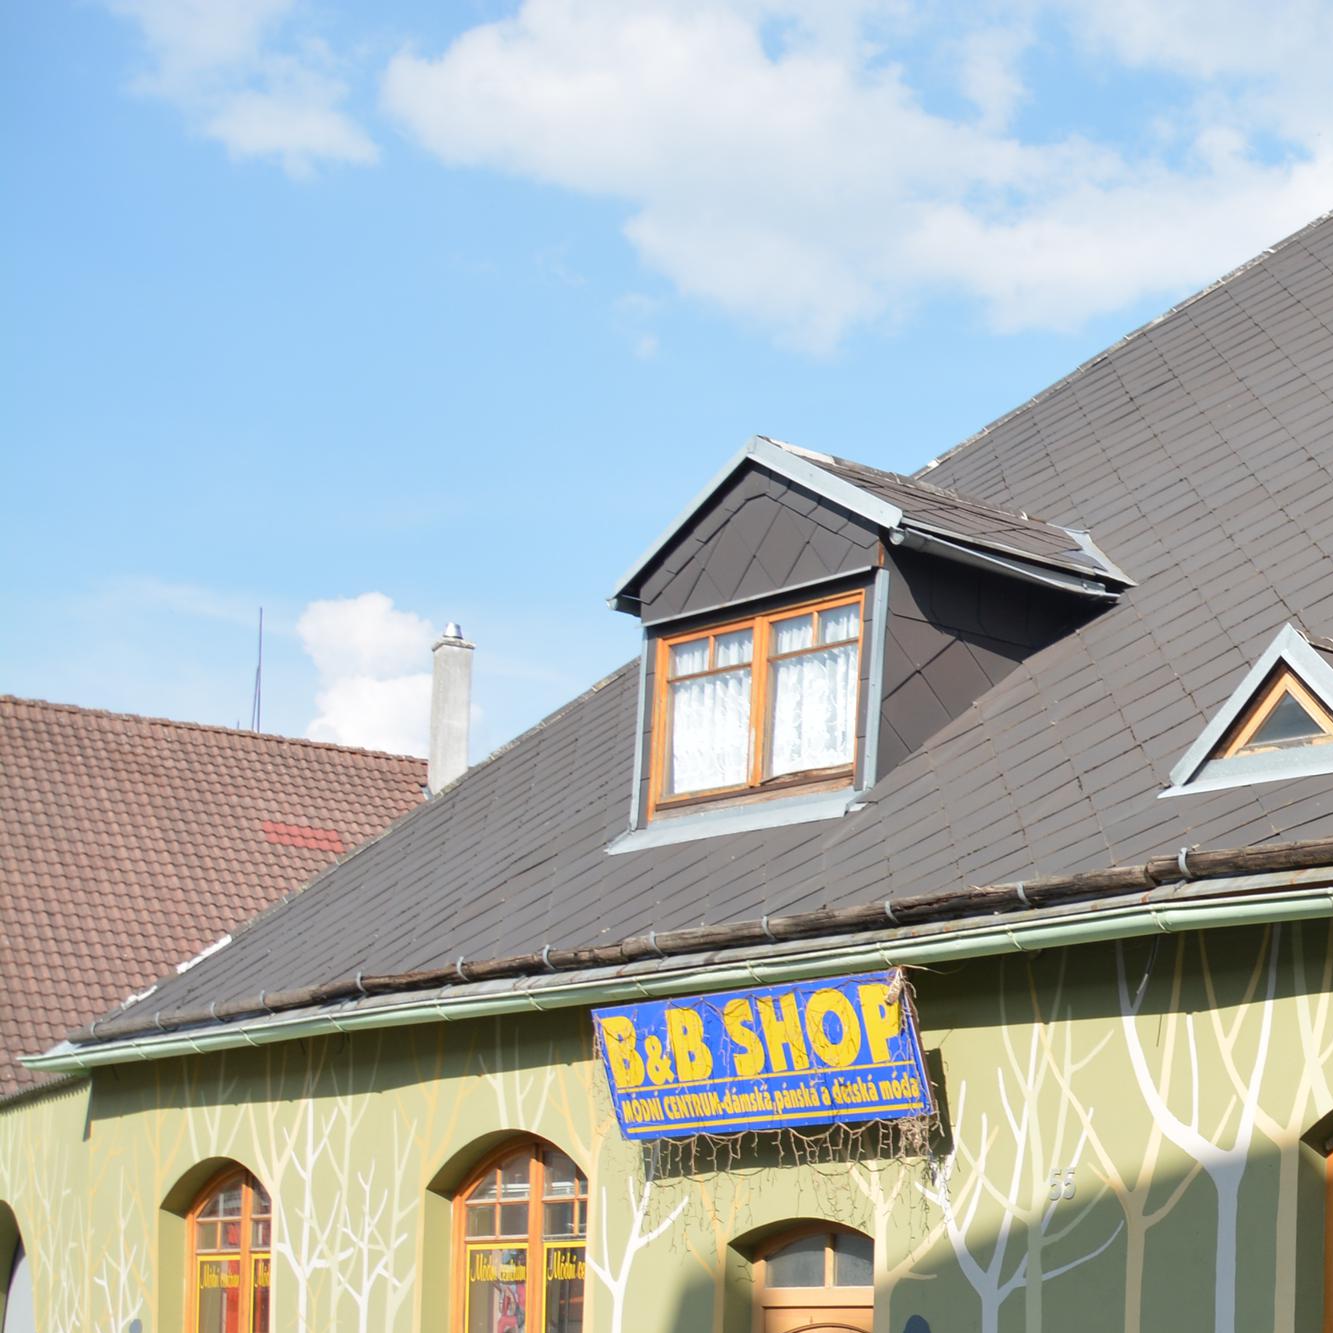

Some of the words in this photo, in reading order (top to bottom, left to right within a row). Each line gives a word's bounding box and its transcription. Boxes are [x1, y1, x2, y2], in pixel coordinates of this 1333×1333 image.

[601, 1006, 713, 1089] B&B
[723, 983, 902, 1077] SHOP
[622, 1092, 664, 1123] MÓDNÍ
[821, 1088, 831, 1105] a
[880, 1073, 920, 1100] móda
